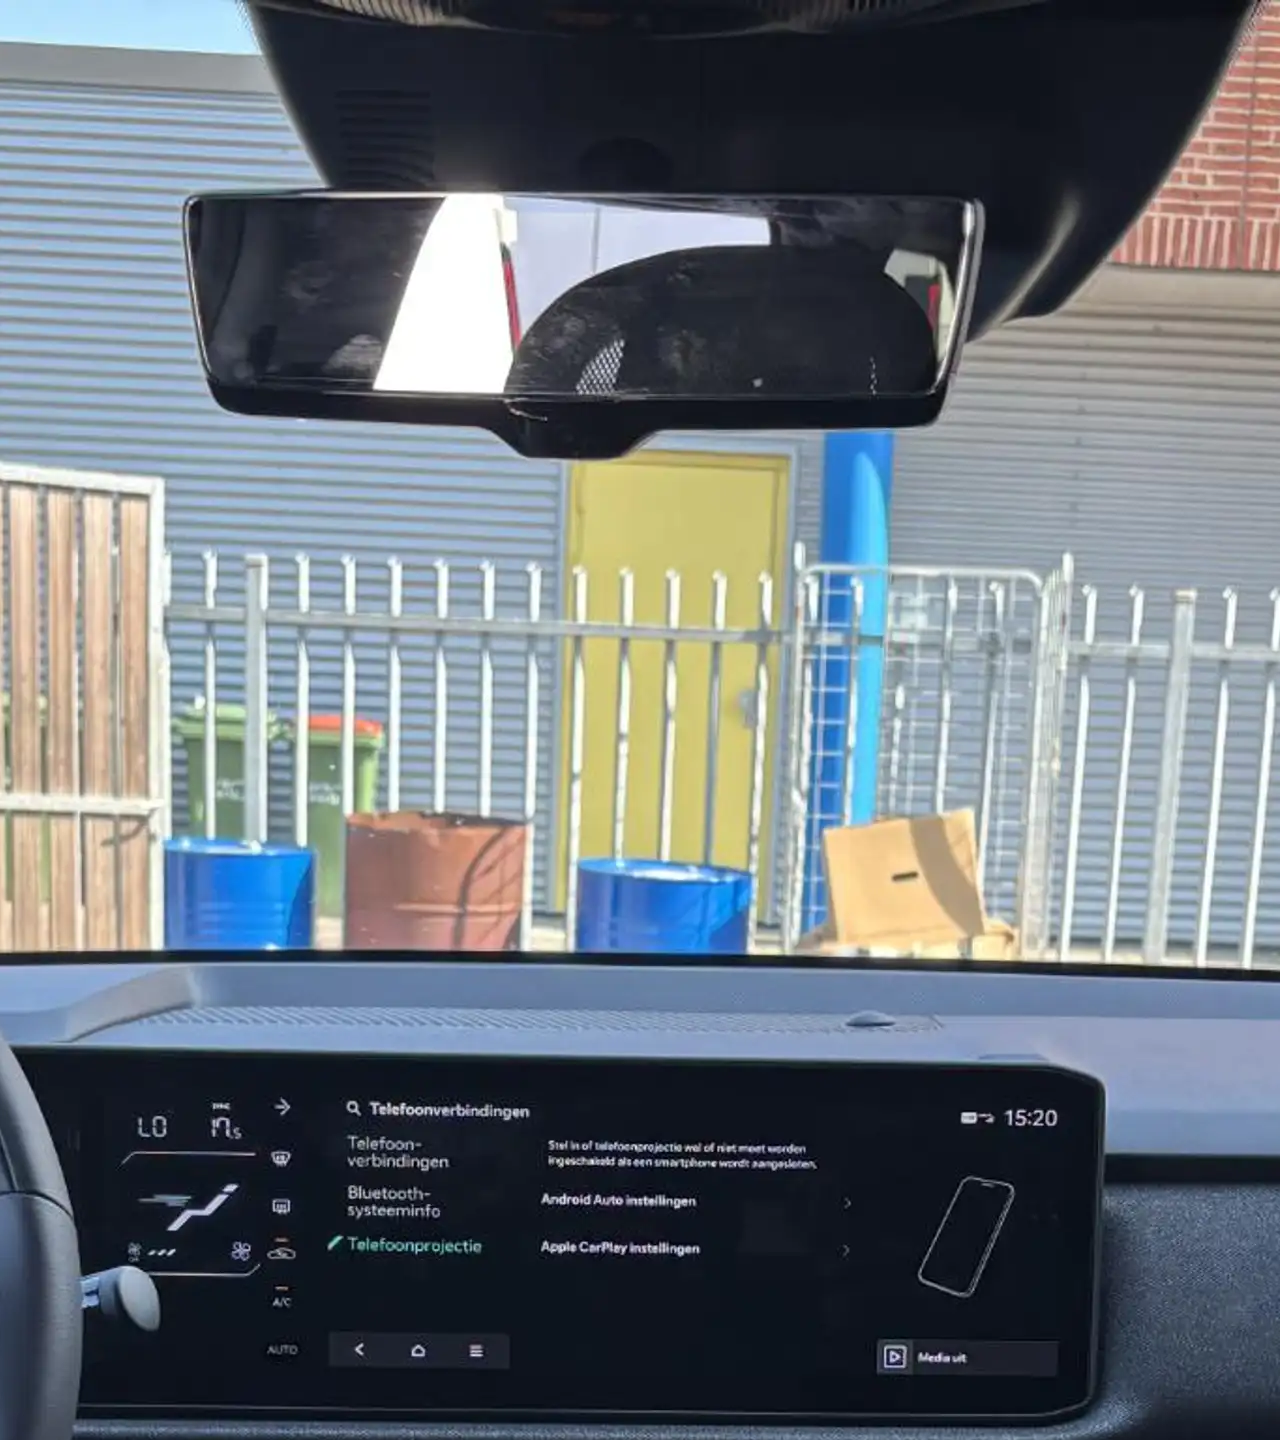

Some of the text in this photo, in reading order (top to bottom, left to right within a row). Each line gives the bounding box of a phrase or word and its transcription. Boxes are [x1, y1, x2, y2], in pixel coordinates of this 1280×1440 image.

[370, 1101, 530, 1120] Telefoonverbindingen
[1004, 1109, 1058, 1127] 15:20
[138, 1115, 168, 1138] LO
[348, 1135, 422, 1151] Telefoon-
[582, 1140, 593, 1150] of
[704, 1142, 715, 1152] of
[717, 1143, 737, 1153] niet
[348, 1154, 450, 1171] verbindingen
[618, 1157, 631, 1167] als
[633, 1158, 653, 1167] een
[655, 1158, 717, 1169] smartphone
[719, 1158, 750, 1168] wordt
[348, 1185, 431, 1201] Bluetooth-
[540, 1193, 697, 1209] Android Auto instellingen
[348, 1203, 441, 1220] systeeminfo
[348, 1235, 483, 1254] Telefoonprojectie
[540, 1240, 701, 1257] Apple CarPlay instellingen
[273, 1298, 291, 1308] A/C
[267, 1344, 298, 1355] AUTO
[918, 1352, 967, 1364] Media uit
